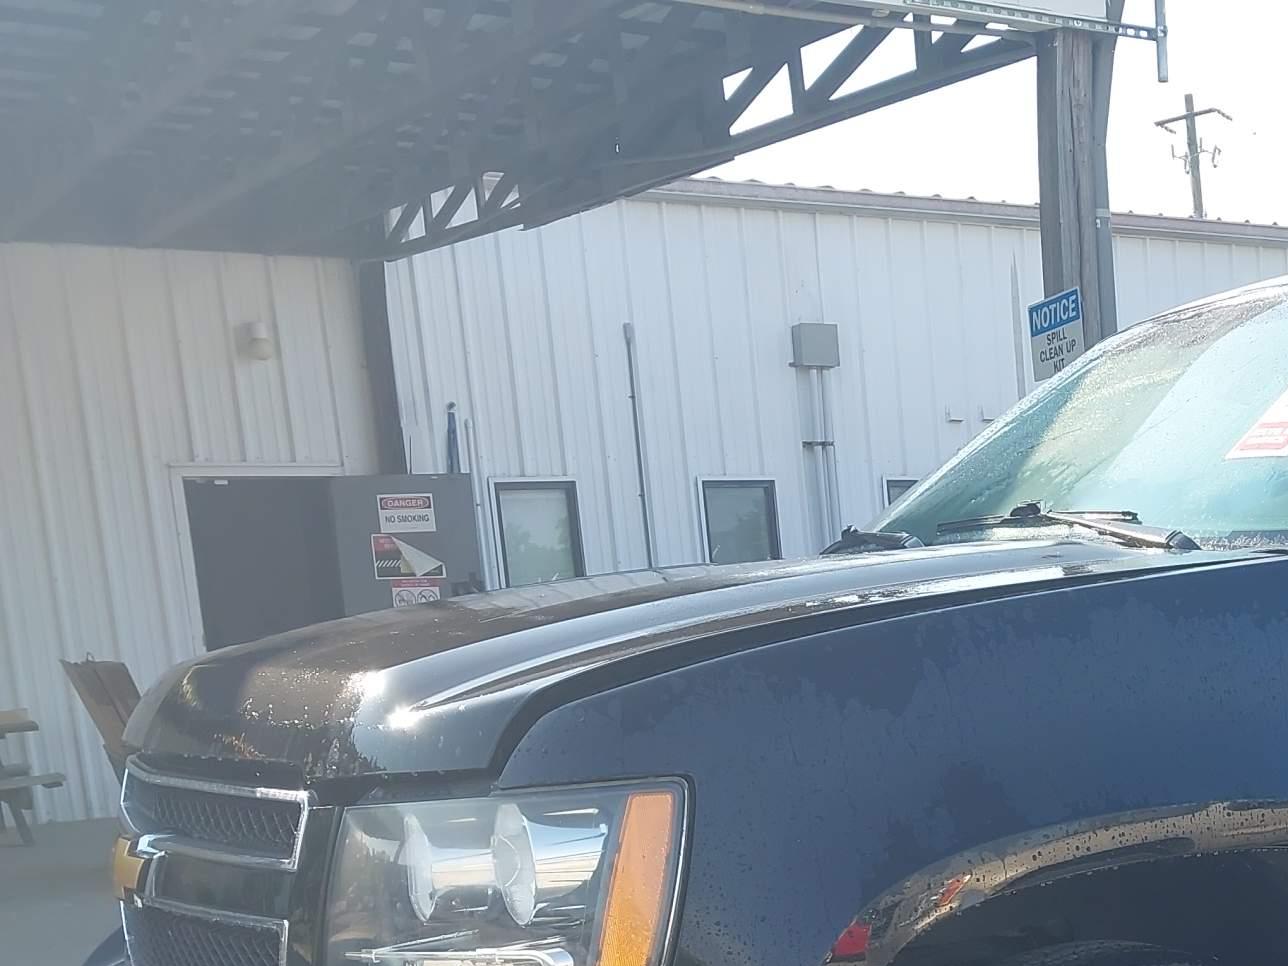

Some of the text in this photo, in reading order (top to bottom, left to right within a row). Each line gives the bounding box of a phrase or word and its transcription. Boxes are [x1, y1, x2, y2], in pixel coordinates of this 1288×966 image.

[1032, 294, 1077, 332] NOTICE
[1046, 327, 1068, 346] SPILL
[1039, 338, 1076, 362] CLEAN UP
[1053, 358, 1065, 373] KIT
[387, 499, 424, 507] DANGER
[384, 514, 430, 523] NO SMOKING
